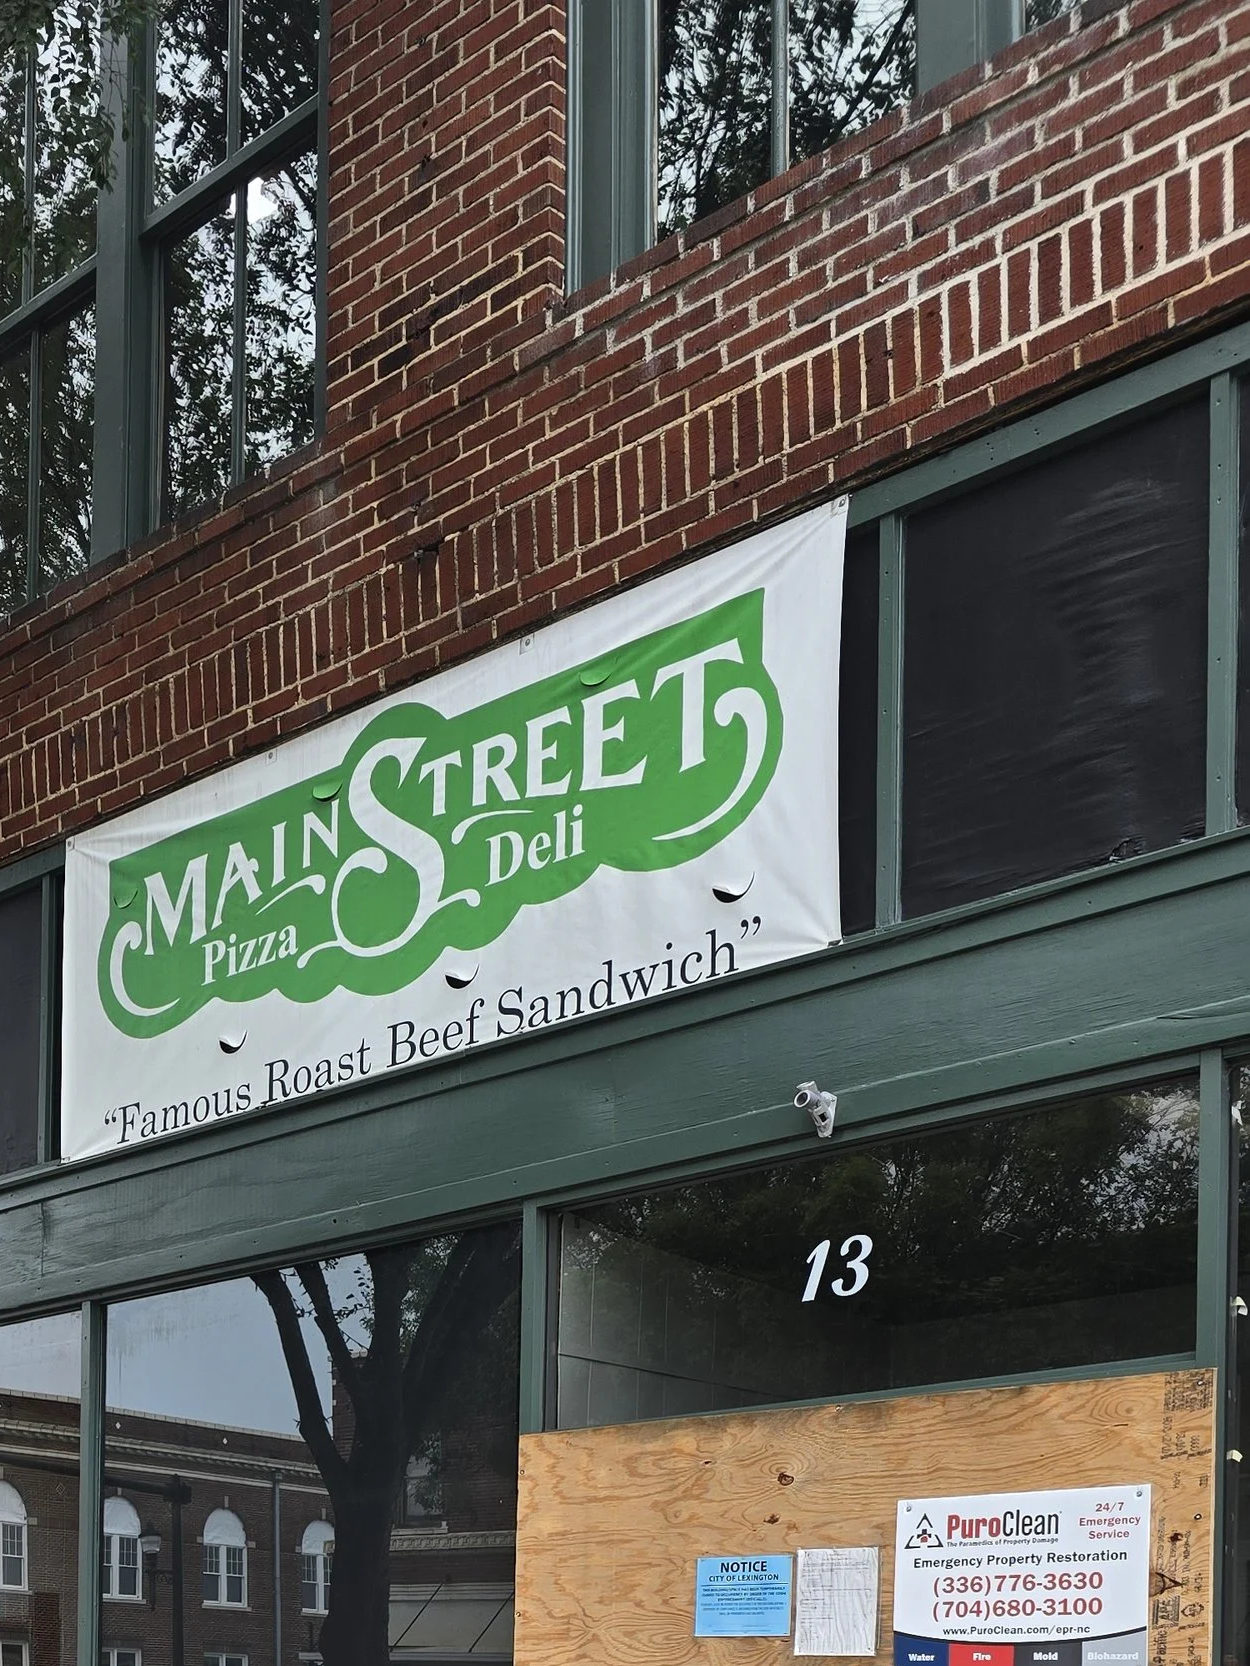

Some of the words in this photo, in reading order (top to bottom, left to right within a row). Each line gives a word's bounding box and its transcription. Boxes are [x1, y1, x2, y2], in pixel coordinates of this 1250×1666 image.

[120, 800, 342, 980] MAIN
[332, 638, 766, 957] STREET
[484, 803, 584, 888] Deli
[202, 925, 299, 986] Pizza
[263, 1040, 372, 1103] Roast
[386, 997, 486, 1068] Beef
[801, 1234, 873, 1302] 13
[1095, 1501, 1125, 1512] 24/7
[947, 1509, 1060, 1540] PuroClean
[1079, 1515, 1141, 1527] Emergency
[1088, 1529, 1130, 1540] Service
[959, 1539, 993, 1548] Paramedics
[1003, 1537, 1031, 1547] Property
[1032, 1536, 1059, 1545] Damage
[913, 1557, 983, 1570] Emergency
[987, 1554, 1043, 1566] Property
[1047, 1550, 1128, 1563] Restoration
[720, 1561, 768, 1573] NOTICE
[737, 1573, 779, 1581] LEXINGTON
[933, 1572, 1104, 1597] (336)776-3630
[932, 1597, 1104, 1622] (704)680-3100
[942, 1625, 1091, 1636] www.PuroClean.com/epr-nc
[908, 1653, 935, 1662] Water
[972, 1652, 992, 1661] Fire
[1033, 1652, 1059, 1661] Mold
[1087, 1651, 1139, 1661] Biohazard
